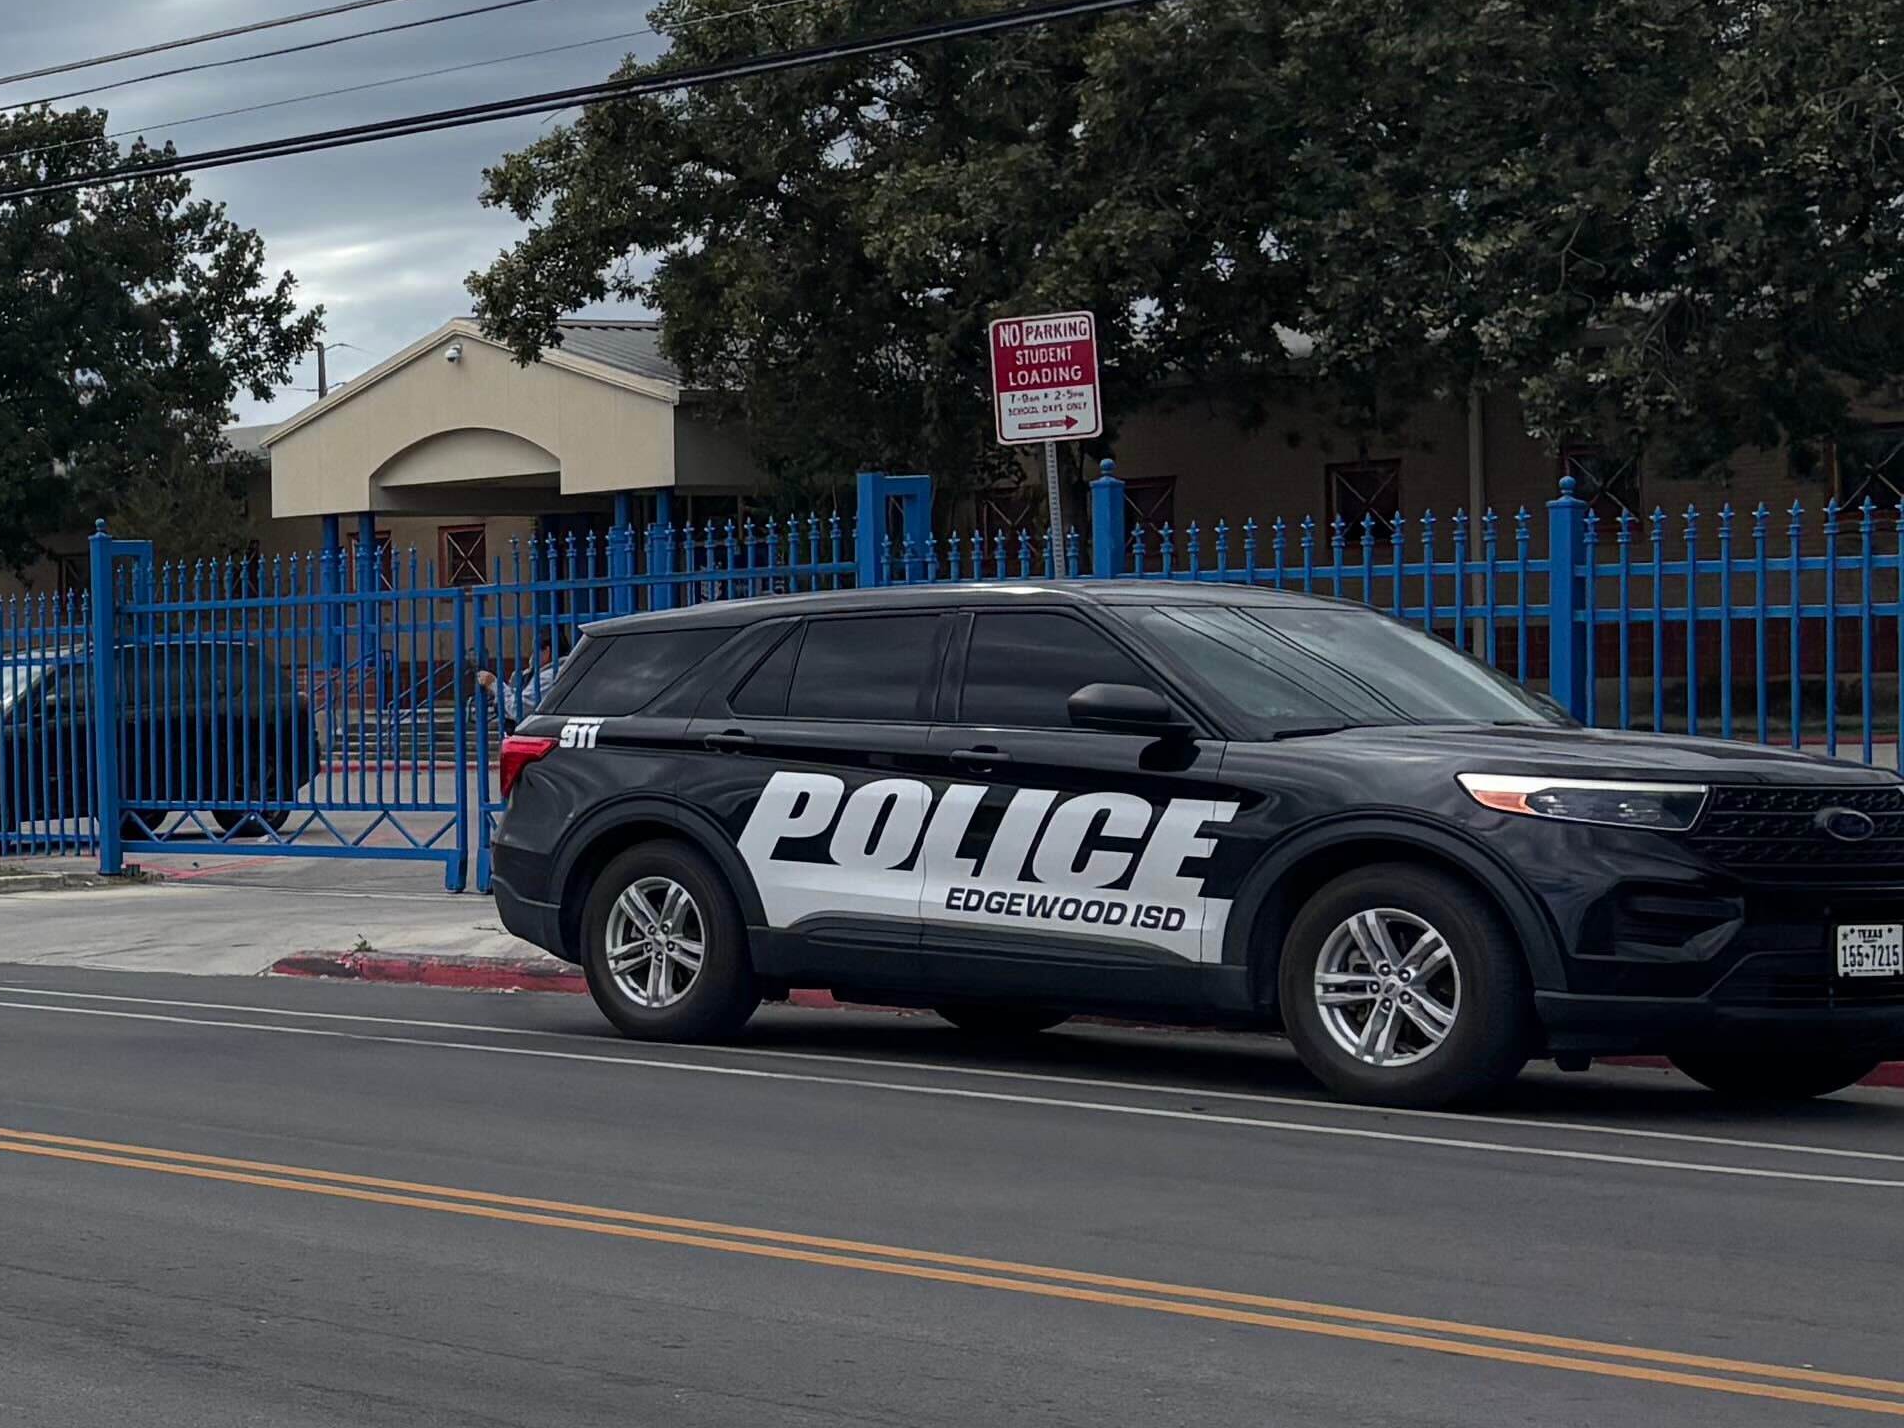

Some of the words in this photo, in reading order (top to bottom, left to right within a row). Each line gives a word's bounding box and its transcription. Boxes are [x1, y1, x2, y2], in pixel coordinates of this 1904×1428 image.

[999, 323, 1020, 348] NO
[1024, 320, 1087, 341] PARKING
[1015, 345, 1072, 365] STUDENT
[1008, 365, 1082, 387] LOADING
[559, 724, 601, 749] 911
[738, 771, 1241, 894] POLICE
[945, 887, 1133, 927] EDGEWOOD
[1131, 904, 1187, 932] ISD
[1857, 928, 1883, 939] TEXAS
